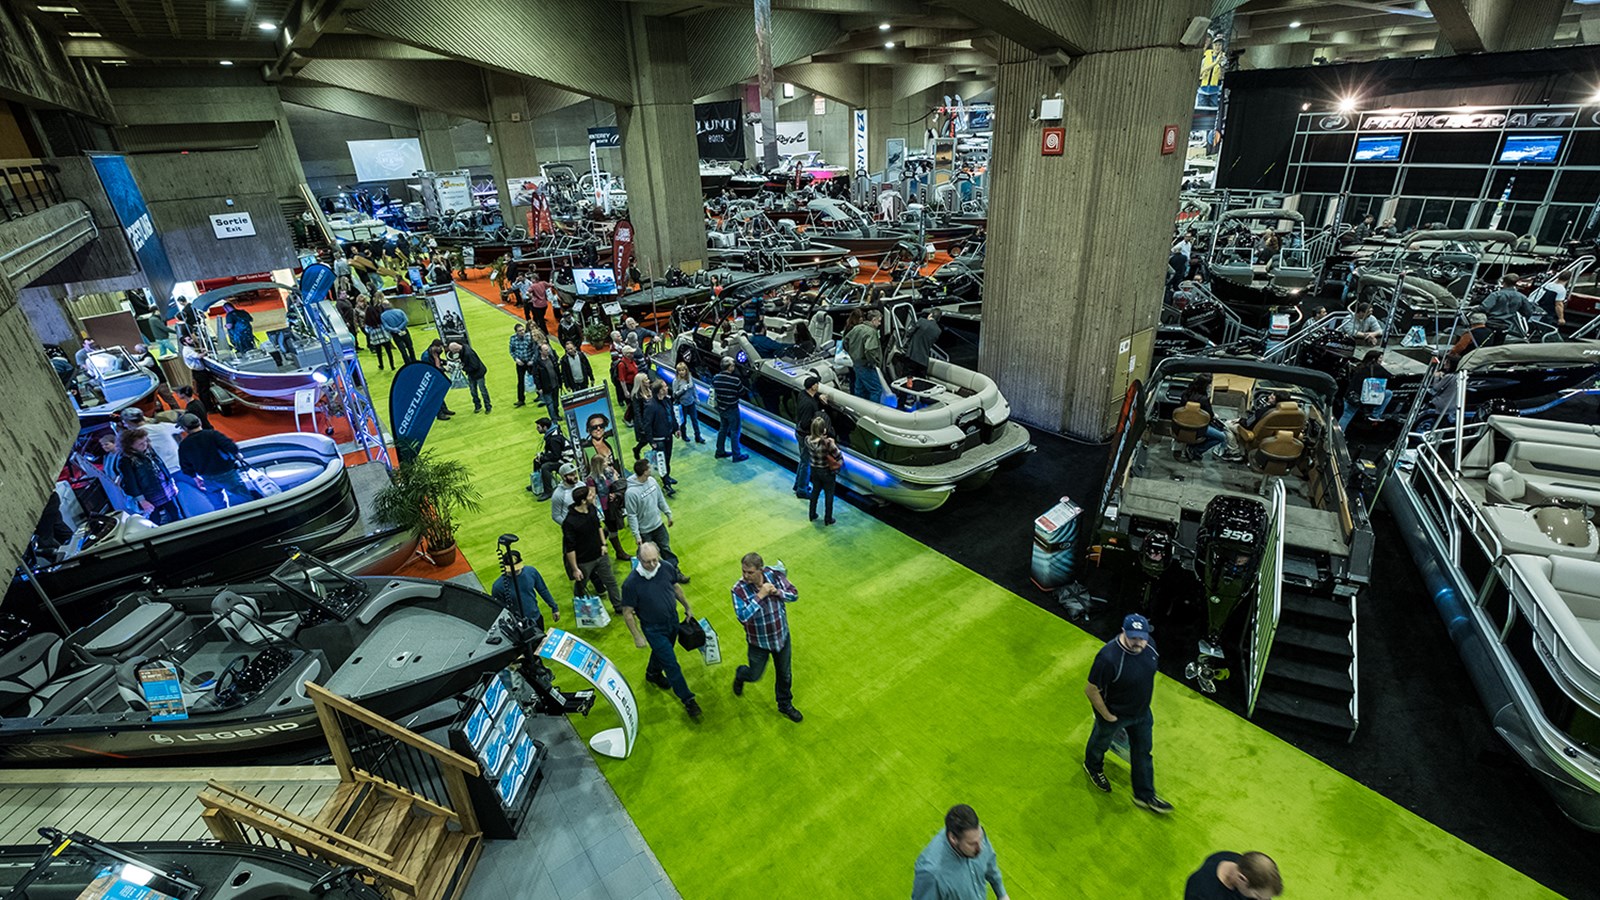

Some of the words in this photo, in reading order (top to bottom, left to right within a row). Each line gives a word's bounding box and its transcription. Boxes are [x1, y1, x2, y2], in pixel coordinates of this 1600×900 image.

[1361, 112, 1576, 130] PRINCECRAFT
[215, 217, 249, 227] Sortie
[398, 371, 433, 435] CRESTLINER
[1220, 528, 1254, 542] 350
[177, 722, 300, 742] LEGEND
